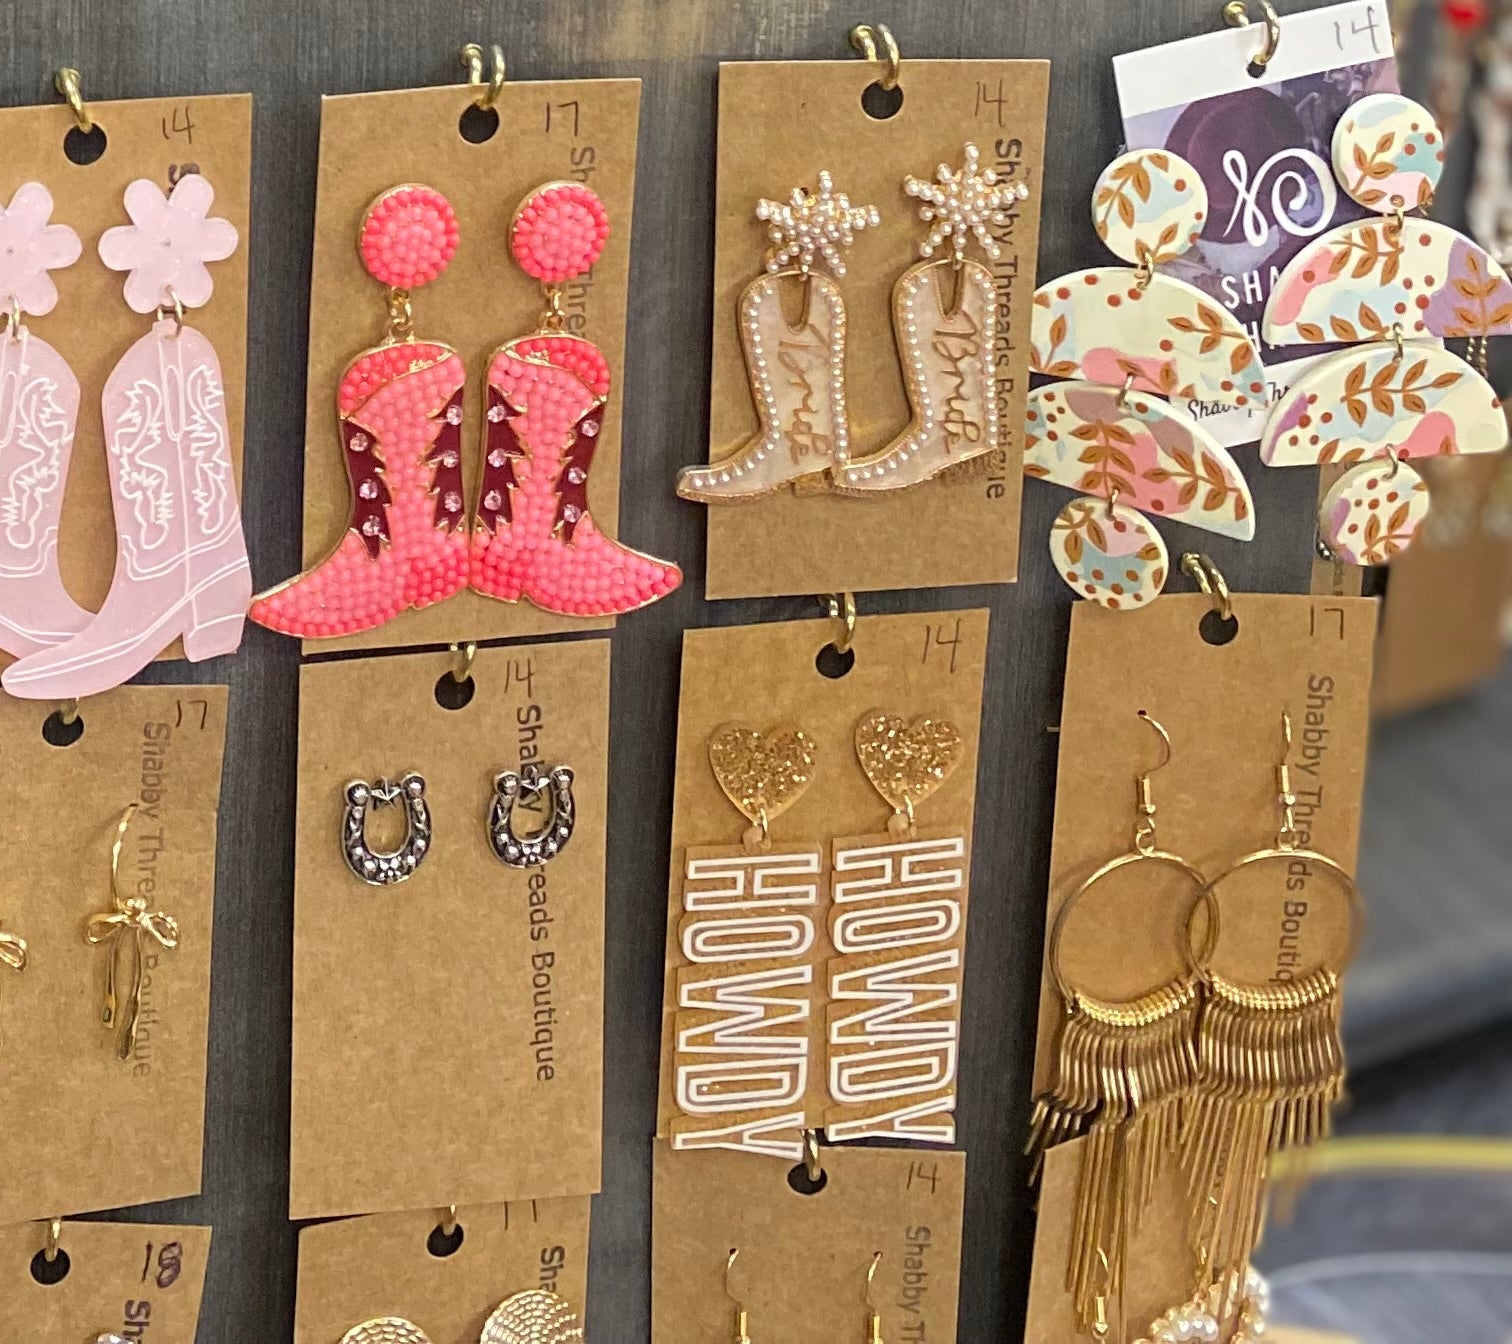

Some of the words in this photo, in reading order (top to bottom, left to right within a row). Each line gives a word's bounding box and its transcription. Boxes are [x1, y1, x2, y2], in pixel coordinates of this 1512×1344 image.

[1333, 5, 1380, 54] 14
[161, 105, 195, 144] 14
[545, 100, 579, 137] 17
[974, 77, 1008, 128] 14
[921, 618, 963, 673] 14
[1309, 603, 1344, 640] 17
[504, 658, 536, 698] 14
[175, 699, 208, 730] 17
[1294, 673, 1335, 777] Shabby
[138, 721, 173, 820] Shabby
[1285, 785, 1323, 891] Threds
[529, 951, 559, 1081] Boutique
[672, 853, 820, 1161] HOWDY
[828, 837, 964, 1144] HOWDY
[906, 1162, 941, 1194] 14
[141, 1240, 183, 1289] 18
[896, 1225, 931, 1314] Shabby
